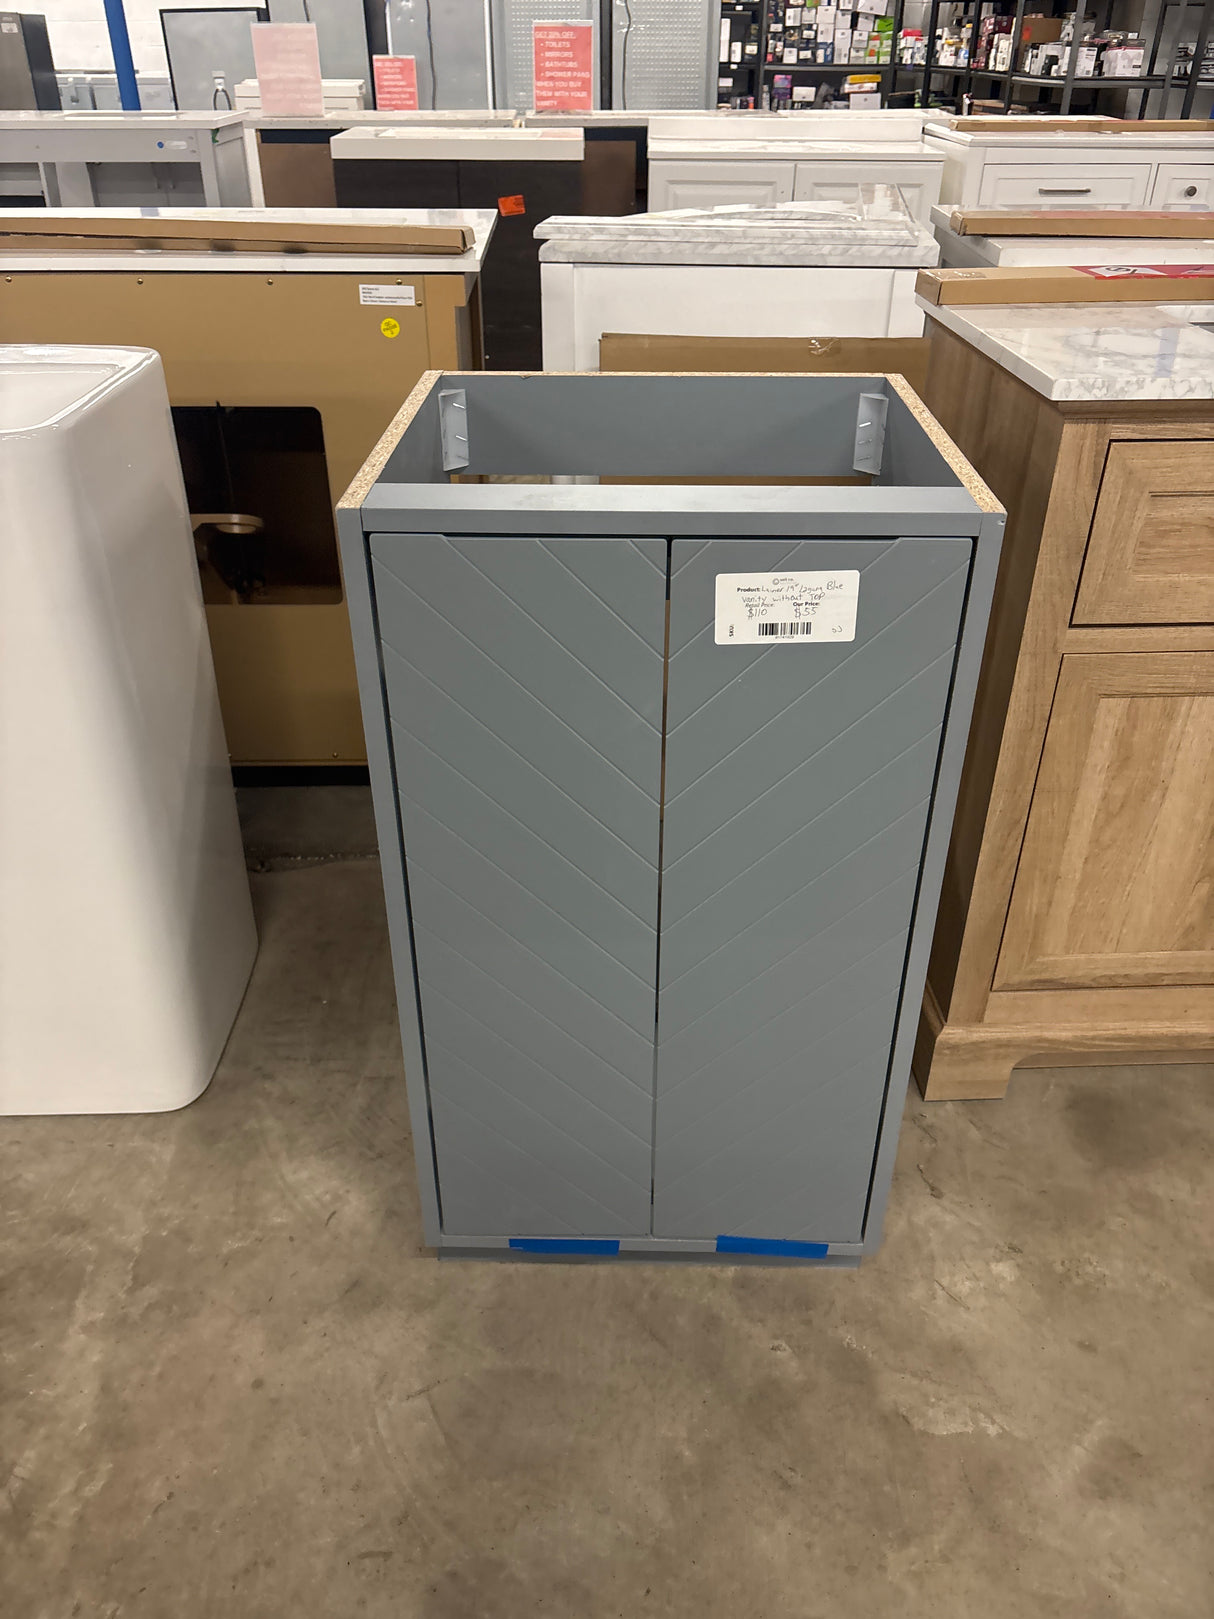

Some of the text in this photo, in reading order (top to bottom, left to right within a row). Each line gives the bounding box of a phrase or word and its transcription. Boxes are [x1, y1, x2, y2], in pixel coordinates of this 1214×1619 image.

[826, 580, 844, 591] Blue
[747, 607, 768, 620] $110
[794, 606, 818, 619] $55
